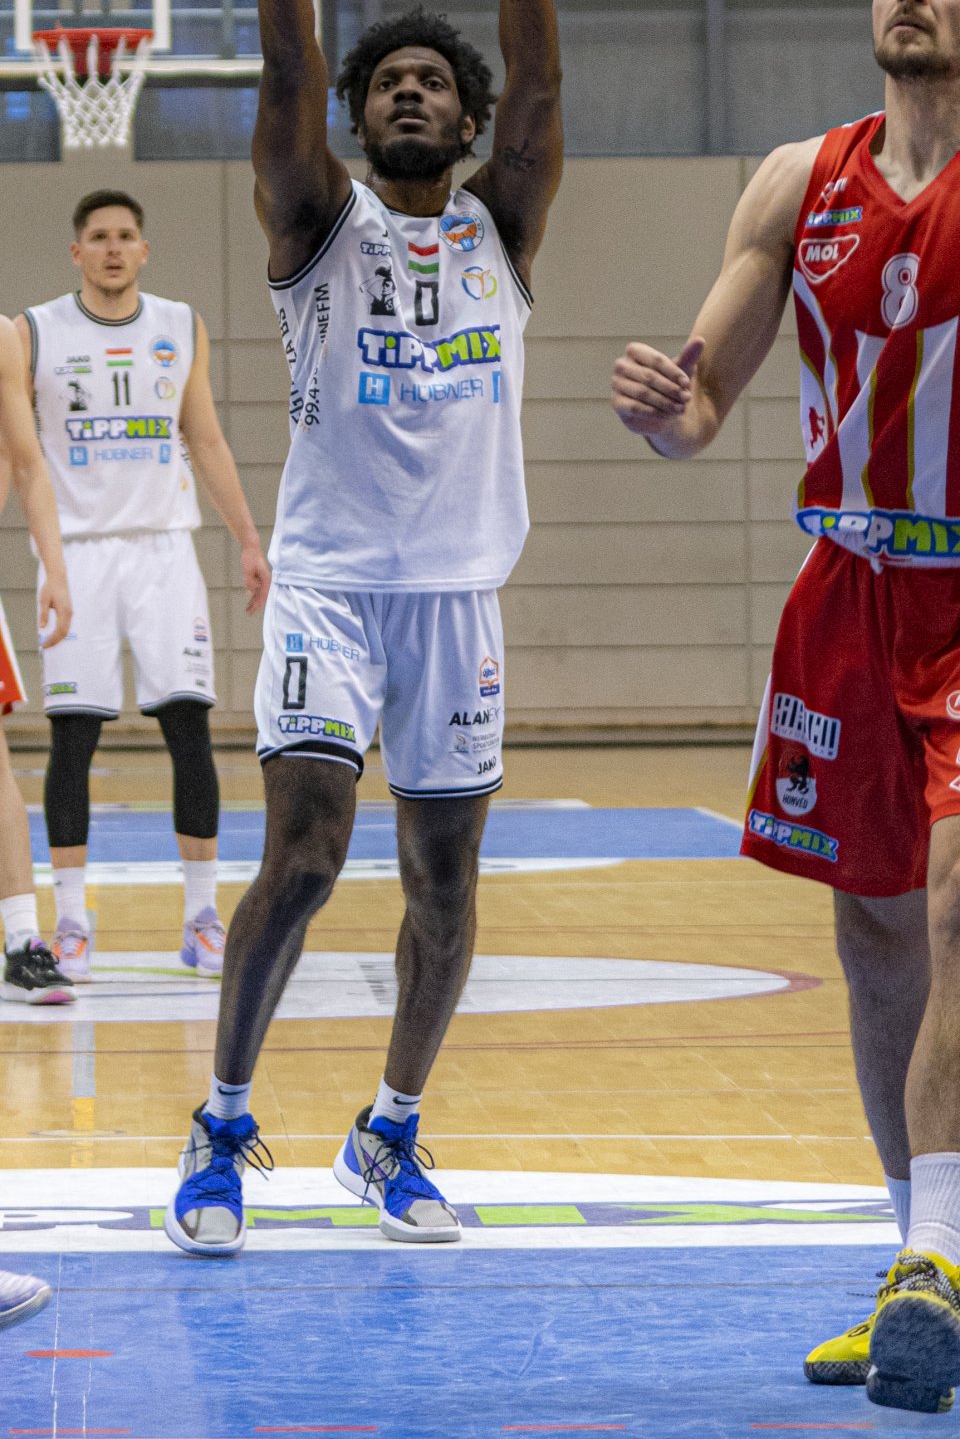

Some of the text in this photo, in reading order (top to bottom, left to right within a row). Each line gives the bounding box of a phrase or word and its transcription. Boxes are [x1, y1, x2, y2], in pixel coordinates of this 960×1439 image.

[805, 244, 839, 262] MOL
[414, 280, 439, 326] 0
[881, 253, 920, 329] 8
[112, 371, 131, 406] 11
[65, 416, 172, 441] TiPPMIX
[282, 656, 308, 710] 0
[278, 714, 356, 743] TiPPMIX
